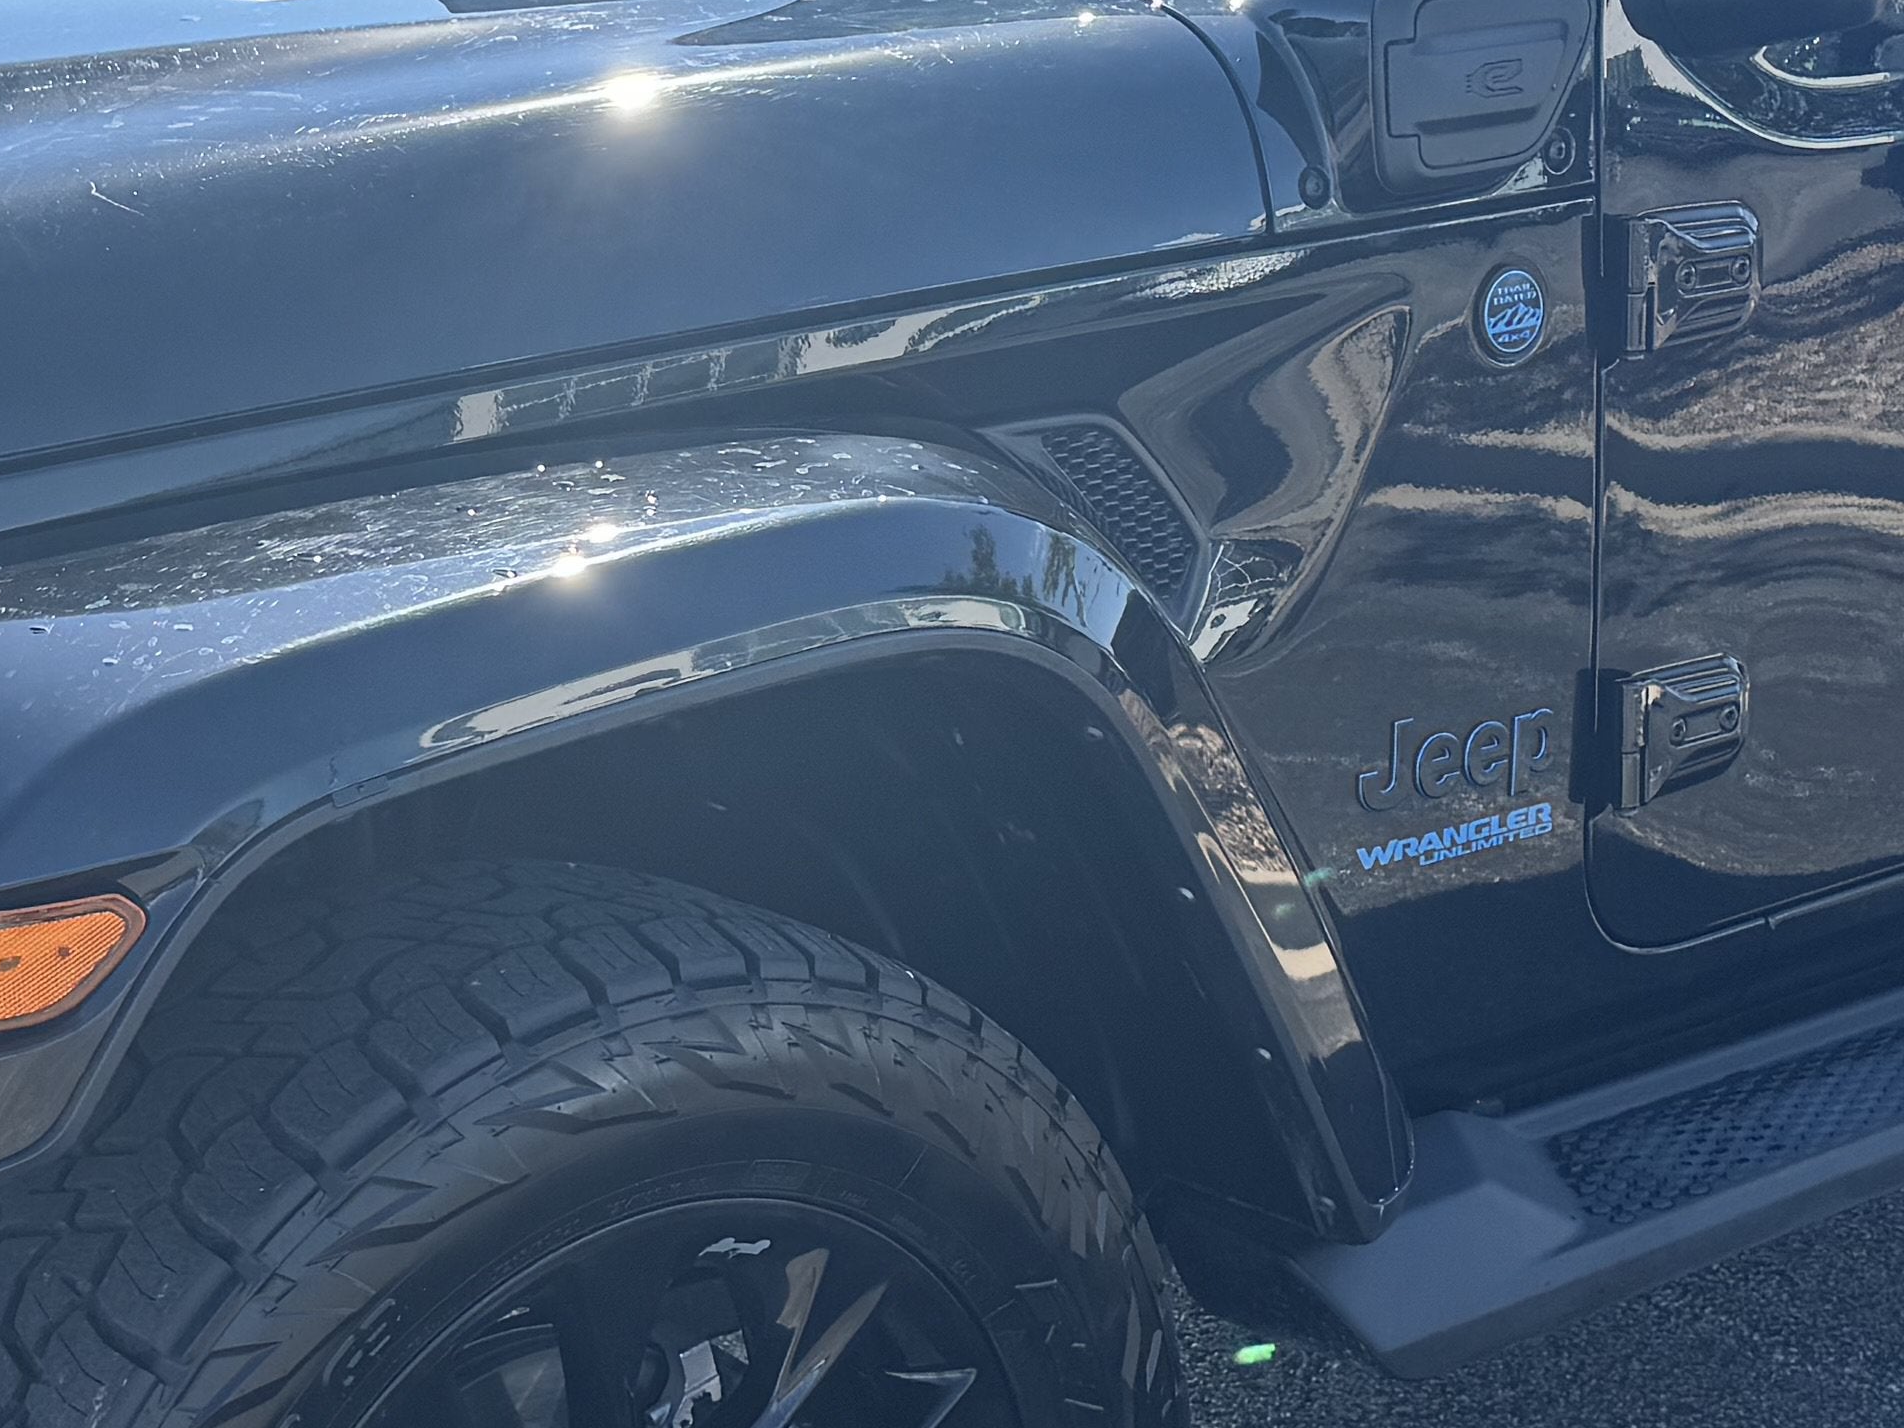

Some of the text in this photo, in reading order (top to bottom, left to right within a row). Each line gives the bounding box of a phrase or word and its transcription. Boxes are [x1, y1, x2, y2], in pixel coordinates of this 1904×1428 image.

[1357, 707, 1553, 812] Jeep
[1357, 802, 1553, 870] WRANGLER
[1419, 822, 1553, 866] UNLIMITED
